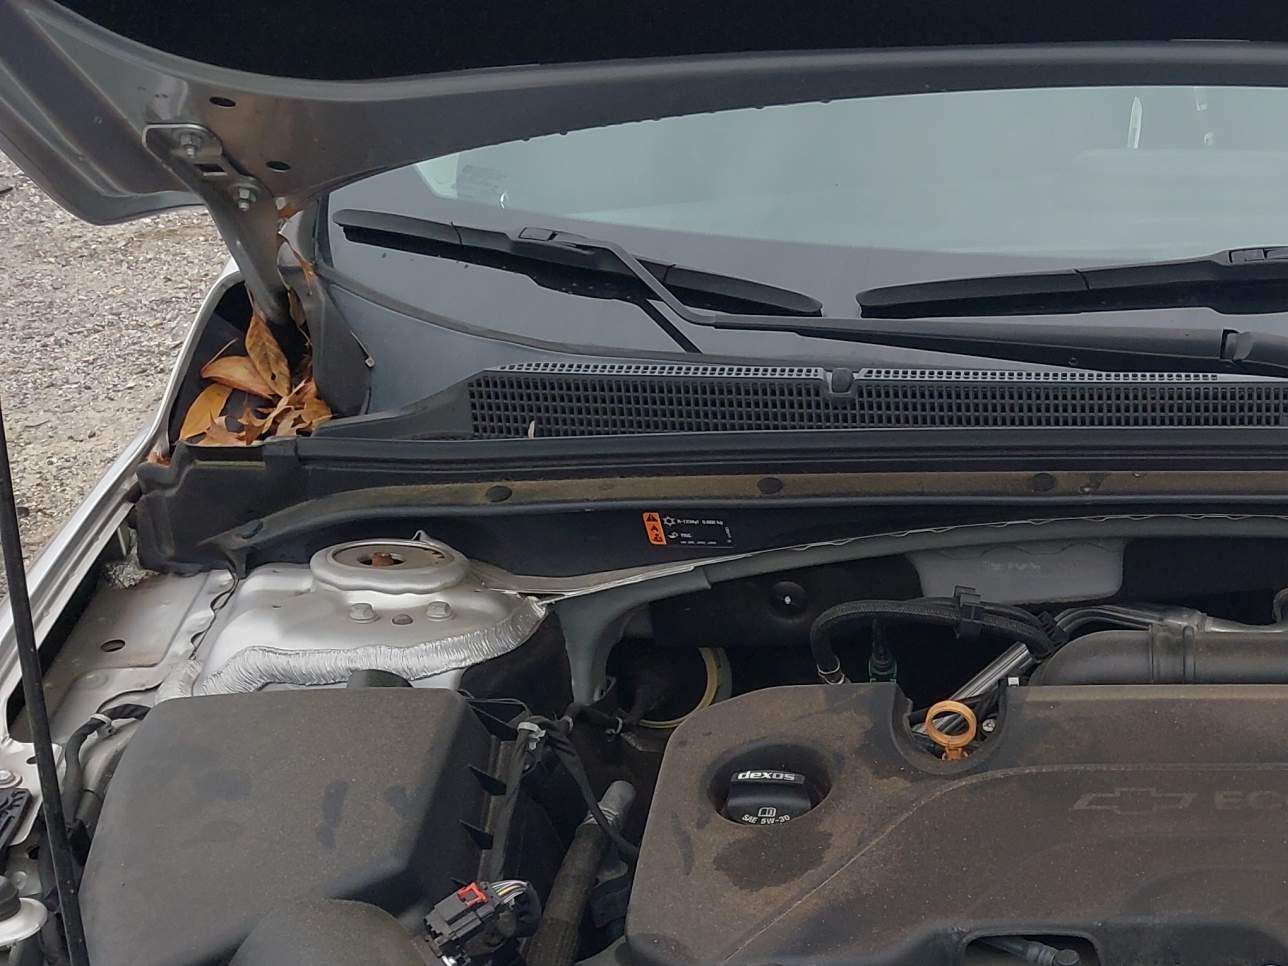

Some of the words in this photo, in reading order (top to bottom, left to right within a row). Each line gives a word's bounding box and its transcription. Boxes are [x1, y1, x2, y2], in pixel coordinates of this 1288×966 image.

[737, 770, 796, 782] dexos
[741, 813, 759, 825] SAE
[760, 814, 791, 825] 5W-30
